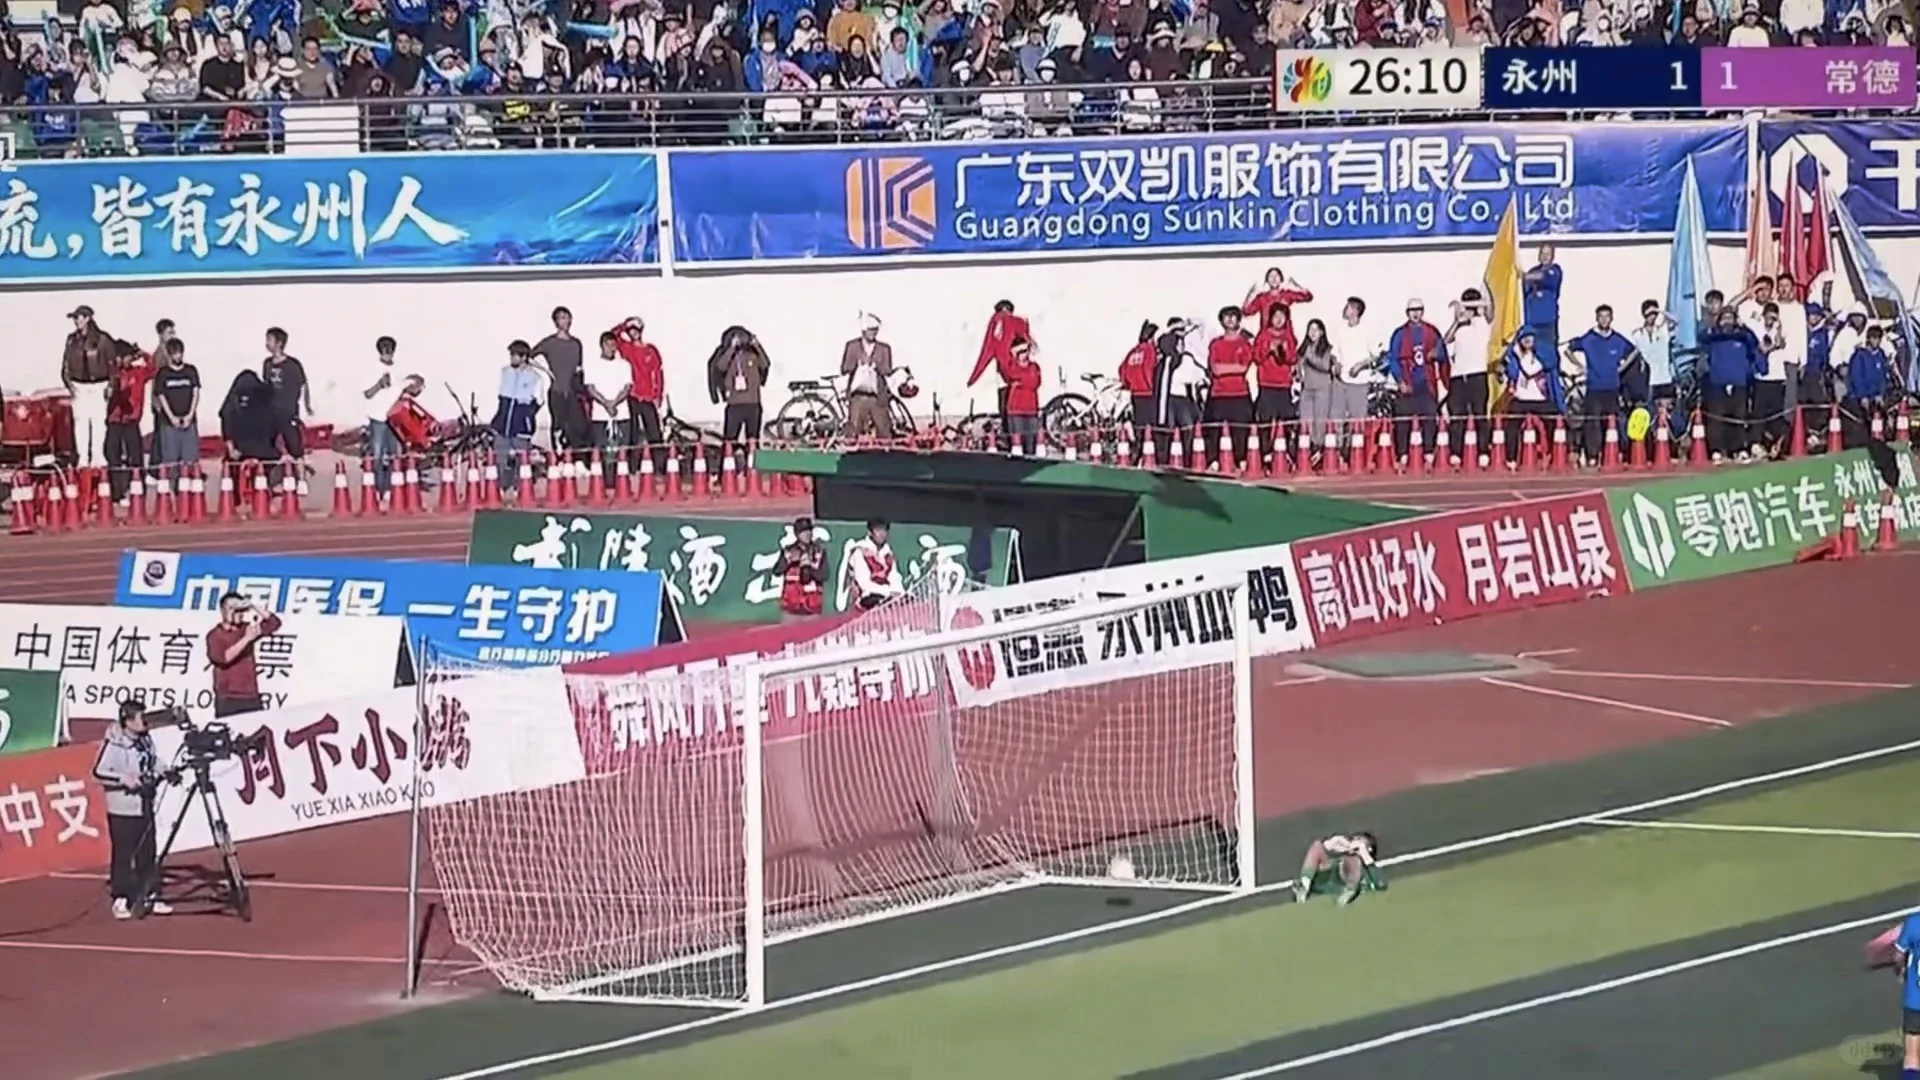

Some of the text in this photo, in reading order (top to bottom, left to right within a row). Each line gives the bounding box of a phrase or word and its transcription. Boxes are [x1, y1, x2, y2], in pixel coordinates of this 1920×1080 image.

[955, 135, 1575, 208] 广东双凯服饰有限公司
[955, 207, 1151, 243] Guangdong
[1164, 200, 1276, 232] Sunkin
[1289, 195, 1435, 230] Clothing
[1525, 190, 1574, 220] Ltd
[1675, 476, 1836, 557] 零跑汽车
[1300, 505, 1617, 633] 高山好水 月岩山泉
[408, 584, 617, 644] 一生守护
[14, 622, 298, 681] 中国体育票
[291, 801, 324, 822] YUE
[329, 795, 357, 816] XIA
[357, 786, 398, 811] XIAO
